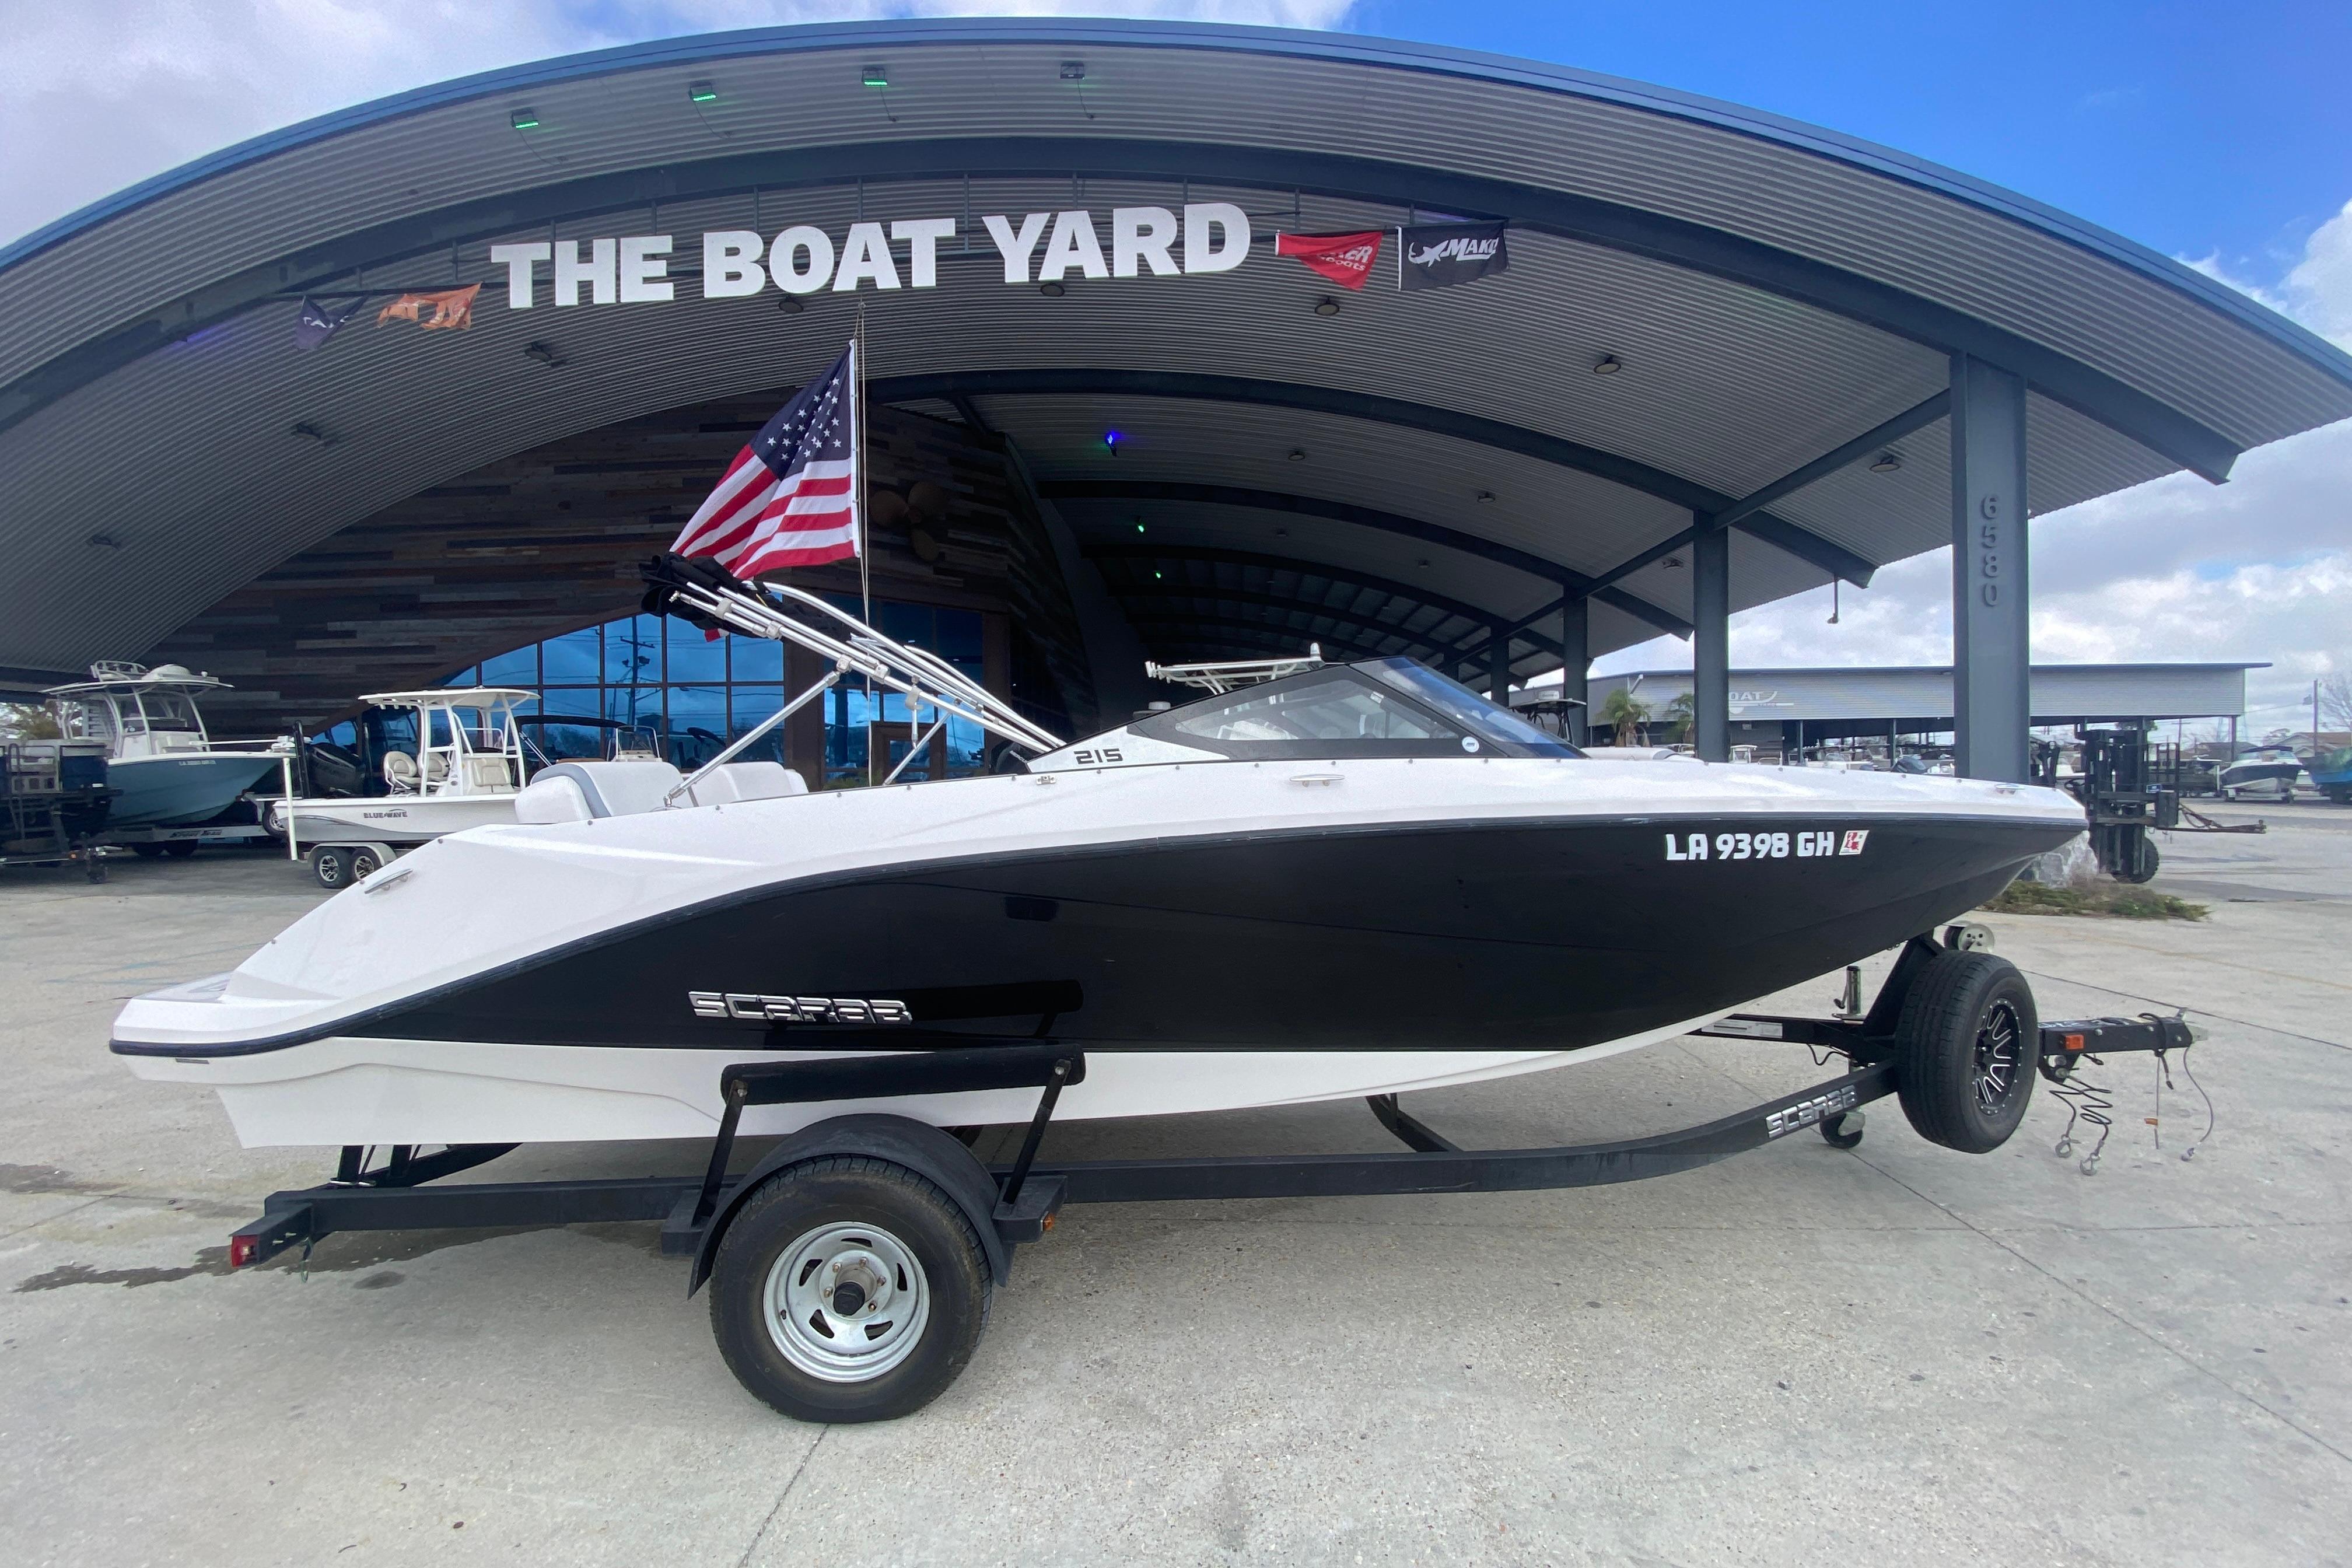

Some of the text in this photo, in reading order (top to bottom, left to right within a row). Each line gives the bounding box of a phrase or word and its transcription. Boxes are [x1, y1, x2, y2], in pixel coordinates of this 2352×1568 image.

[491, 203, 1251, 309] THE BOAT YARD
[1982, 494, 2000, 607] 6580
[1728, 692, 1763, 701] OAT
[1074, 748, 1123, 764] 215
[1665, 831, 1835, 860] LA 9398 GH
